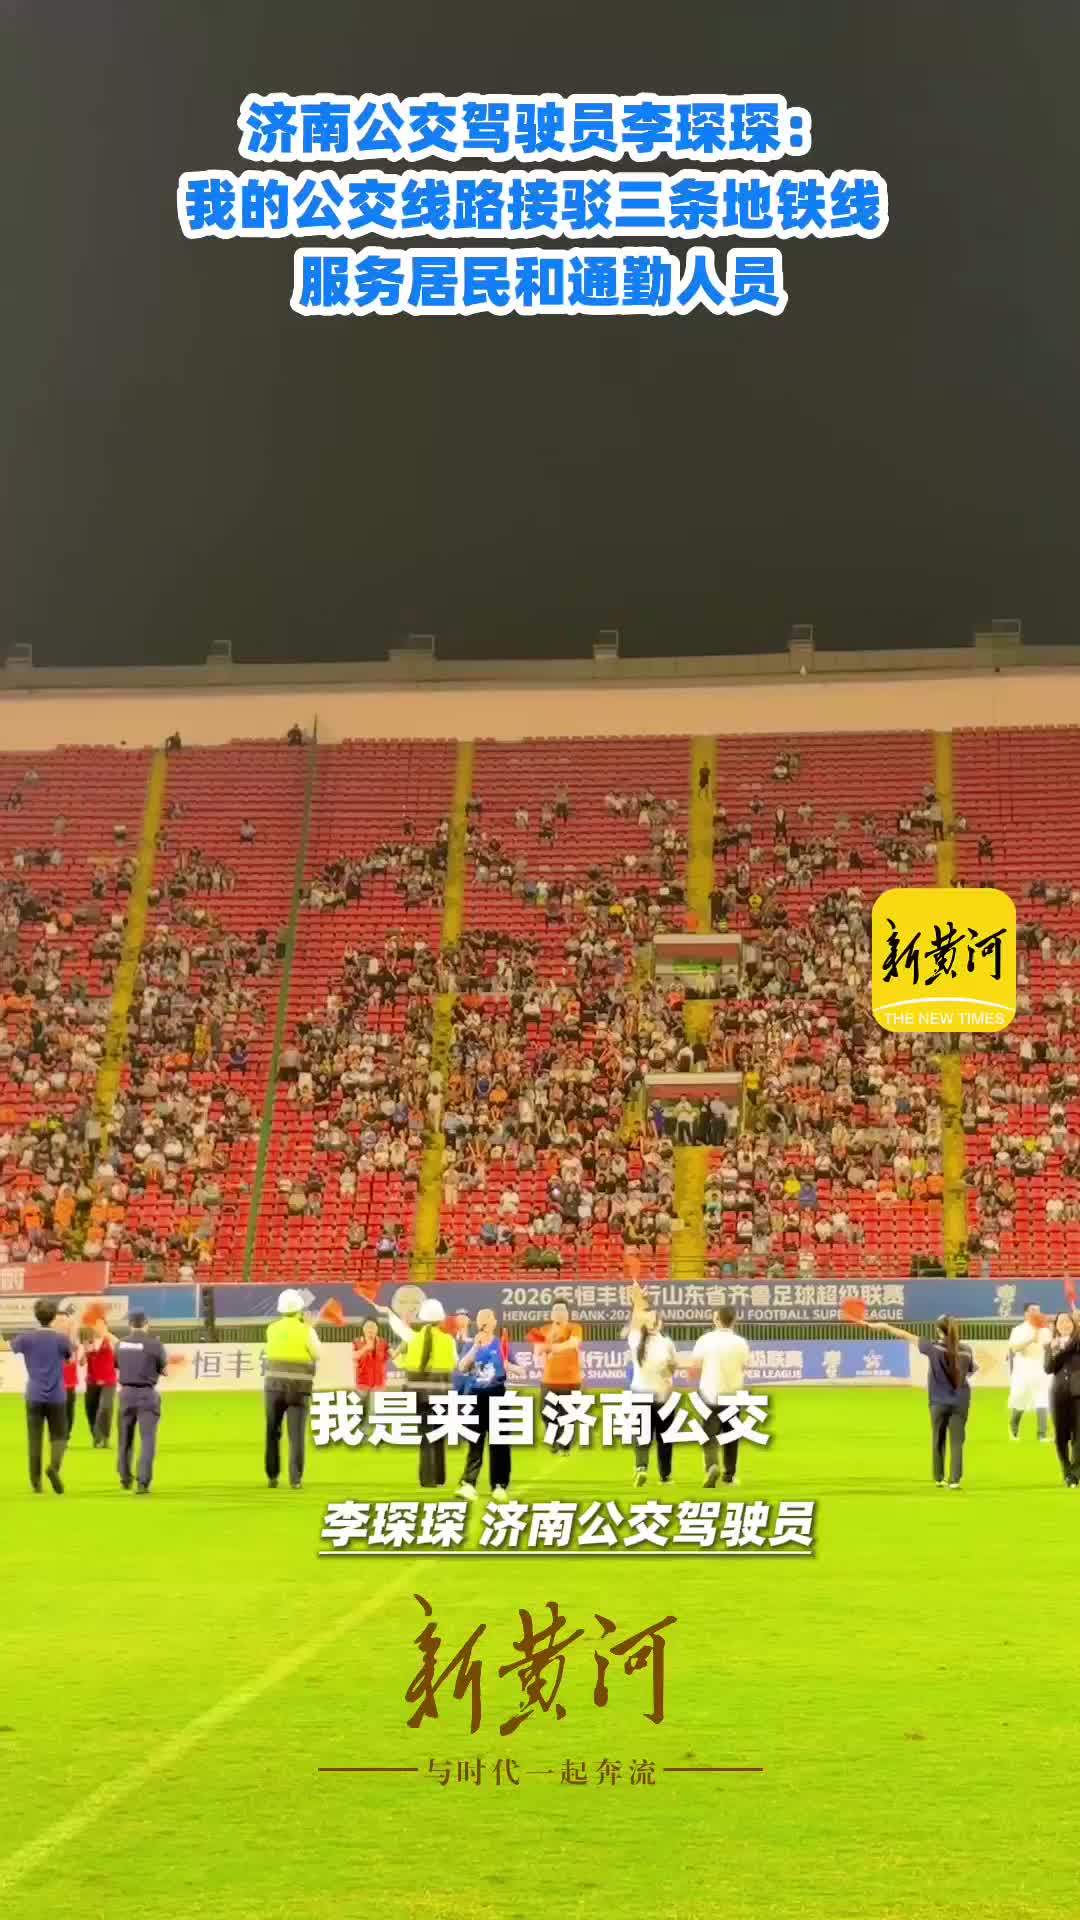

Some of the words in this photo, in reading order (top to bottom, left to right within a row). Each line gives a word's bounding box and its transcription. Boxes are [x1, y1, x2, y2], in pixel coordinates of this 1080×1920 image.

[502, 1310, 550, 1321] HENGFE
[747, 1309, 808, 1321] FOOTBALL
[864, 1308, 904, 1320] EAGUE
